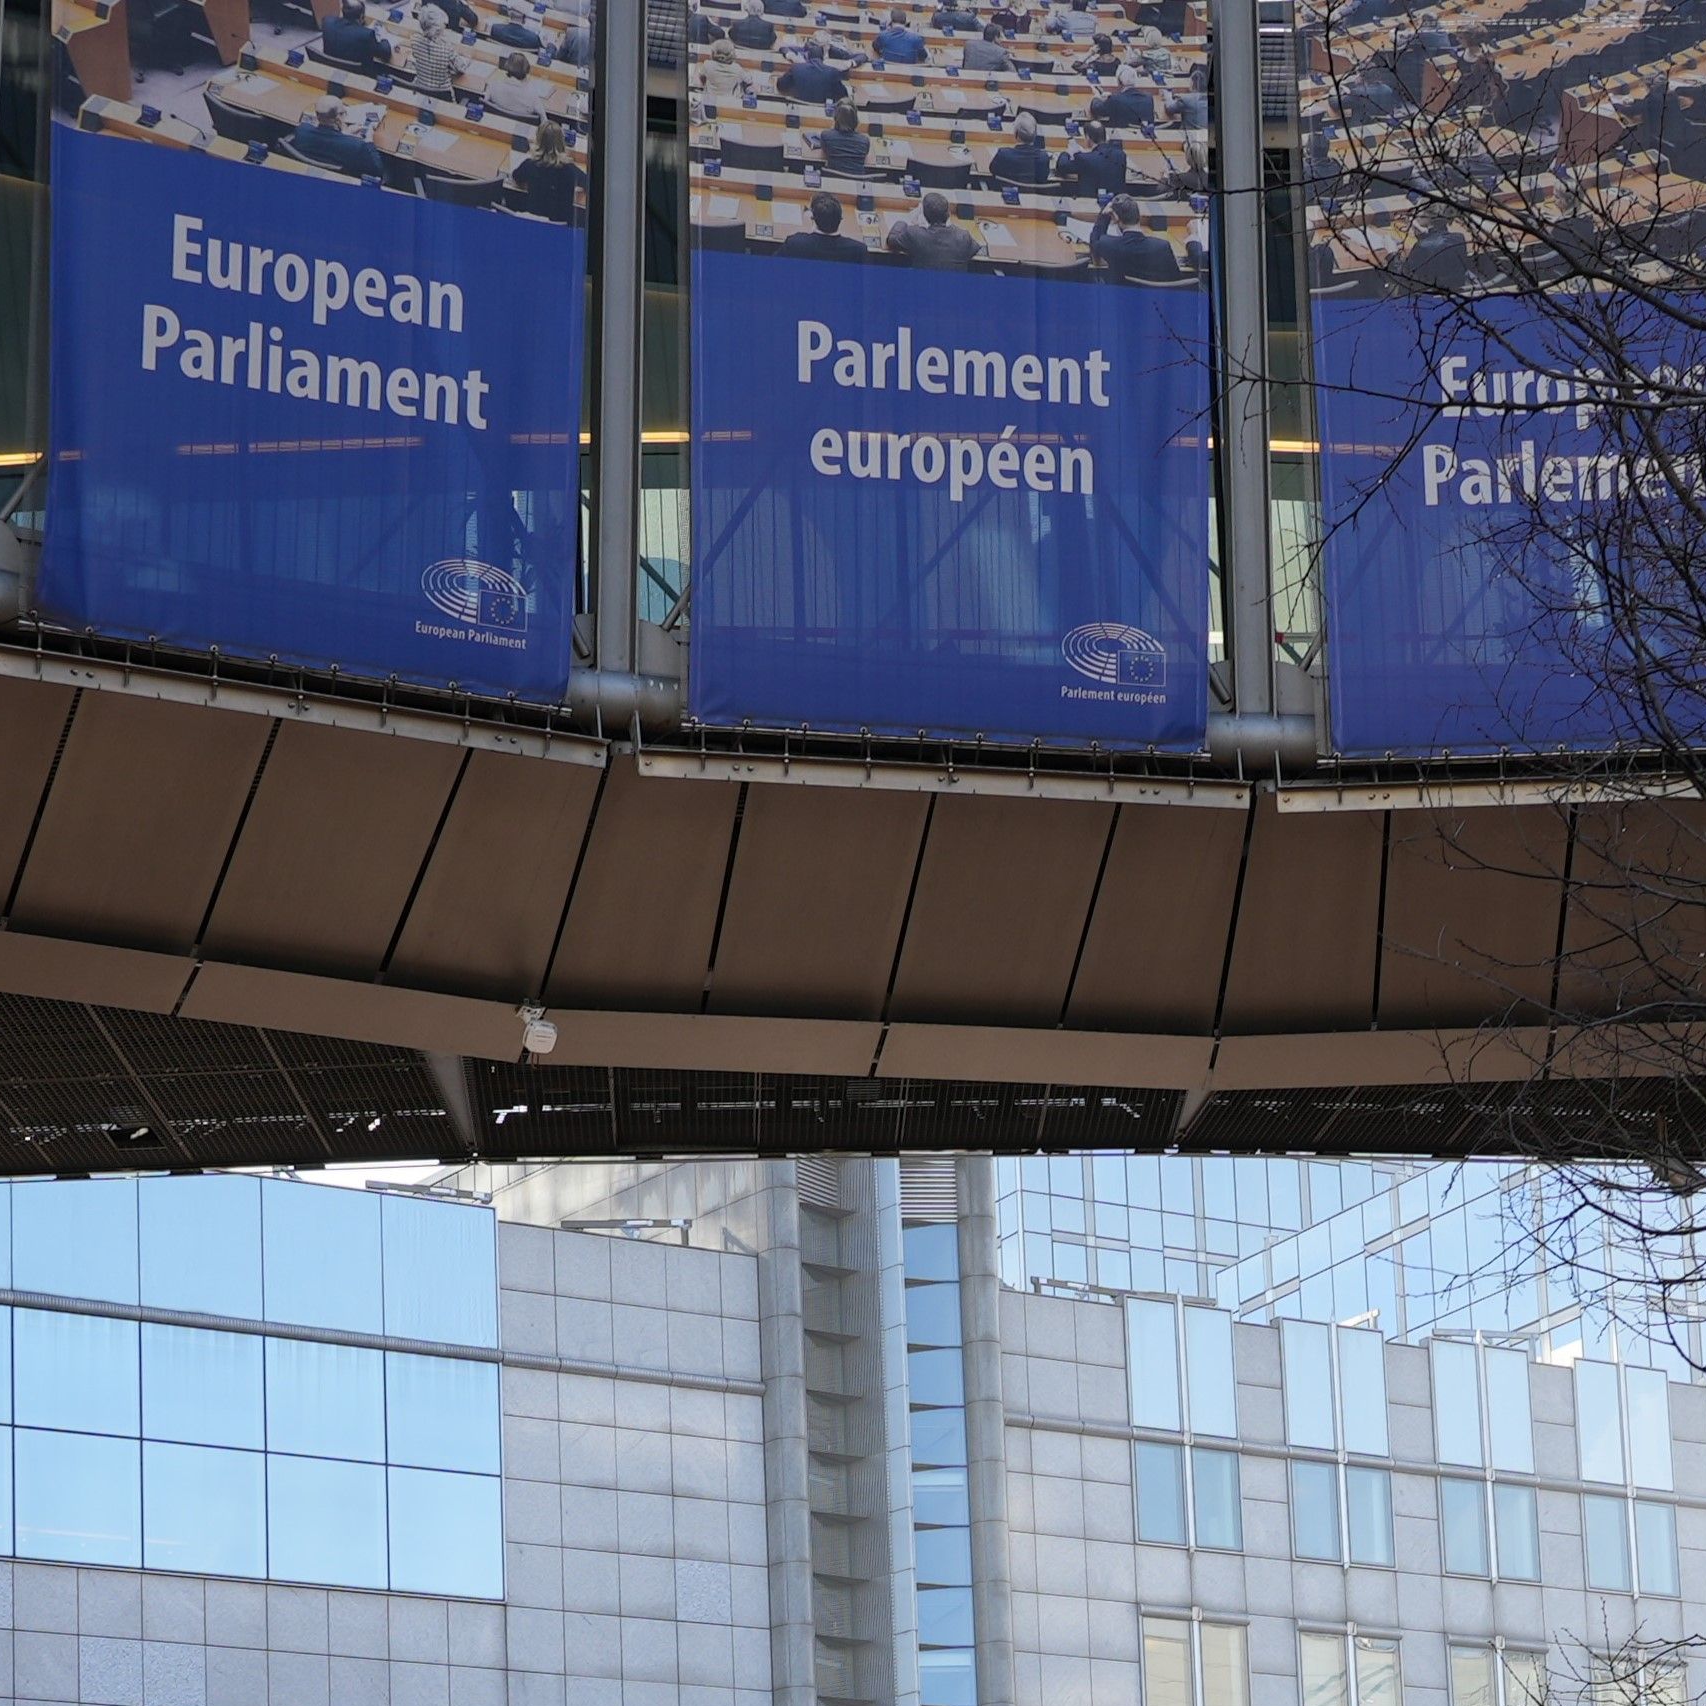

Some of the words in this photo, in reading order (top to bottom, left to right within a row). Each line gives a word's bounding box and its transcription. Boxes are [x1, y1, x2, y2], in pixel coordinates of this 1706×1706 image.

[171, 213, 464, 333] European
[141, 303, 490, 430] Parliament
[797, 319, 1112, 408] Parlement
[809, 425, 1096, 502] européen
[415, 620, 466, 640] European
[467, 628, 527, 649] Parliament
[1060, 685, 1115, 701] Parlement
[1116, 691, 1167, 706] européen
